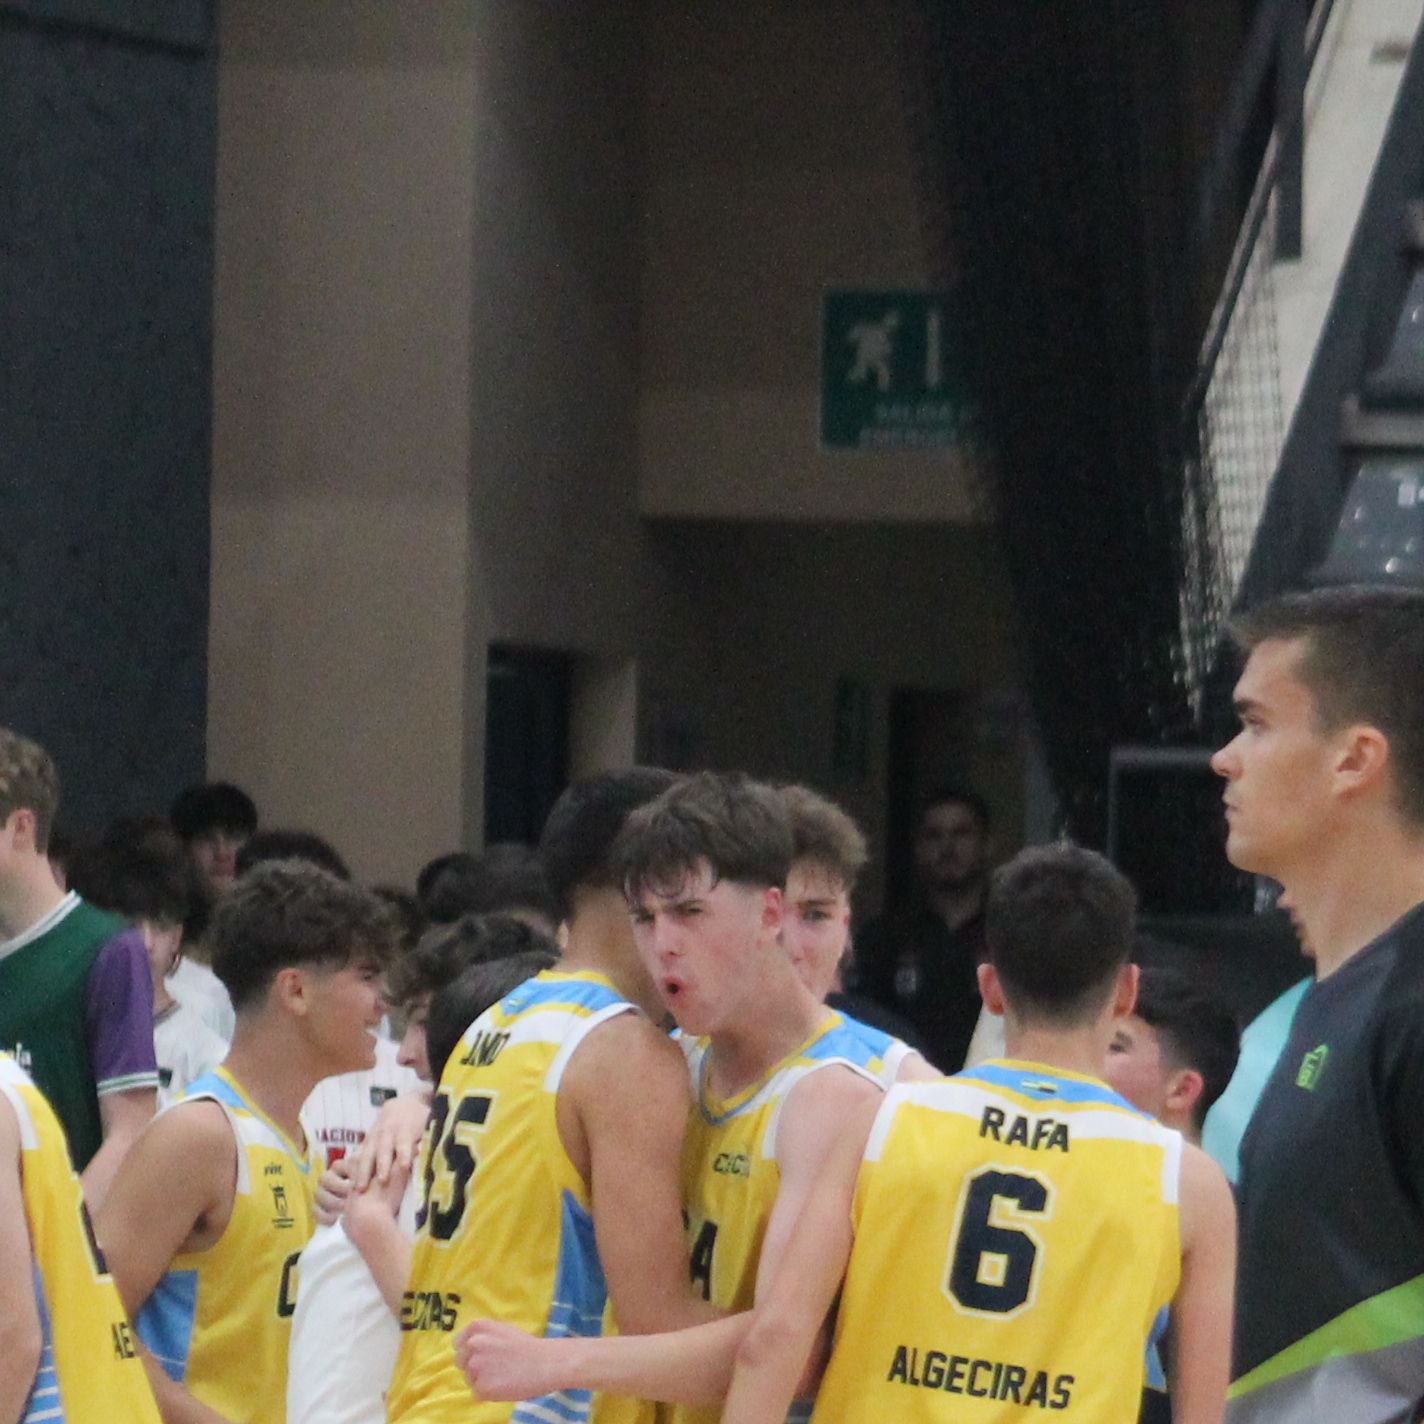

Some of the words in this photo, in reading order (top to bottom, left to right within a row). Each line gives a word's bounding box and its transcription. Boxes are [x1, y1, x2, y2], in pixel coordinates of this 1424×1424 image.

[978, 1105, 1070, 1153] RAFA
[945, 1166, 1051, 1317] 6
[887, 1344, 1075, 1410] ALGECIRAS
